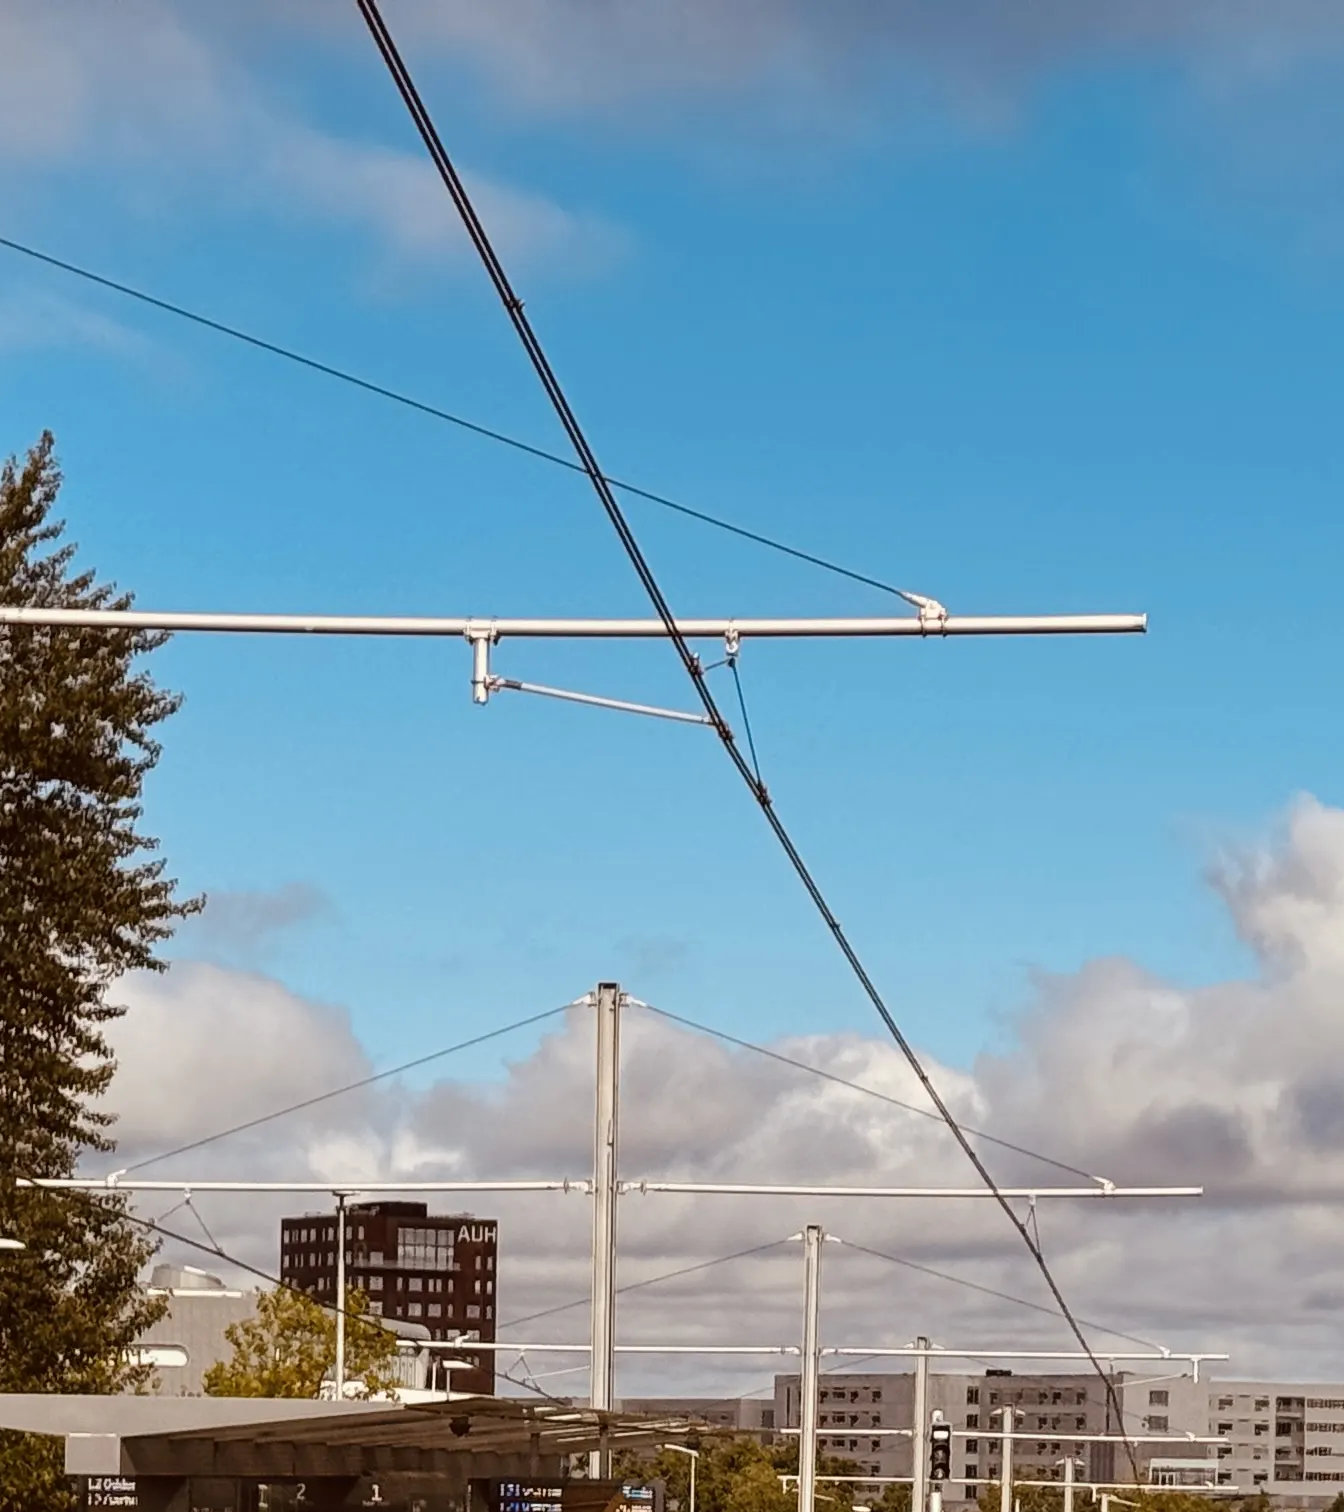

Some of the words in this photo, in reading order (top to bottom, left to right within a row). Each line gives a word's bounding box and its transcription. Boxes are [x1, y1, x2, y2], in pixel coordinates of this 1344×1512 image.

[457, 1225, 496, 1243] AUH
[296, 1483, 306, 1500] 2
[371, 1484, 383, 1501] 1
